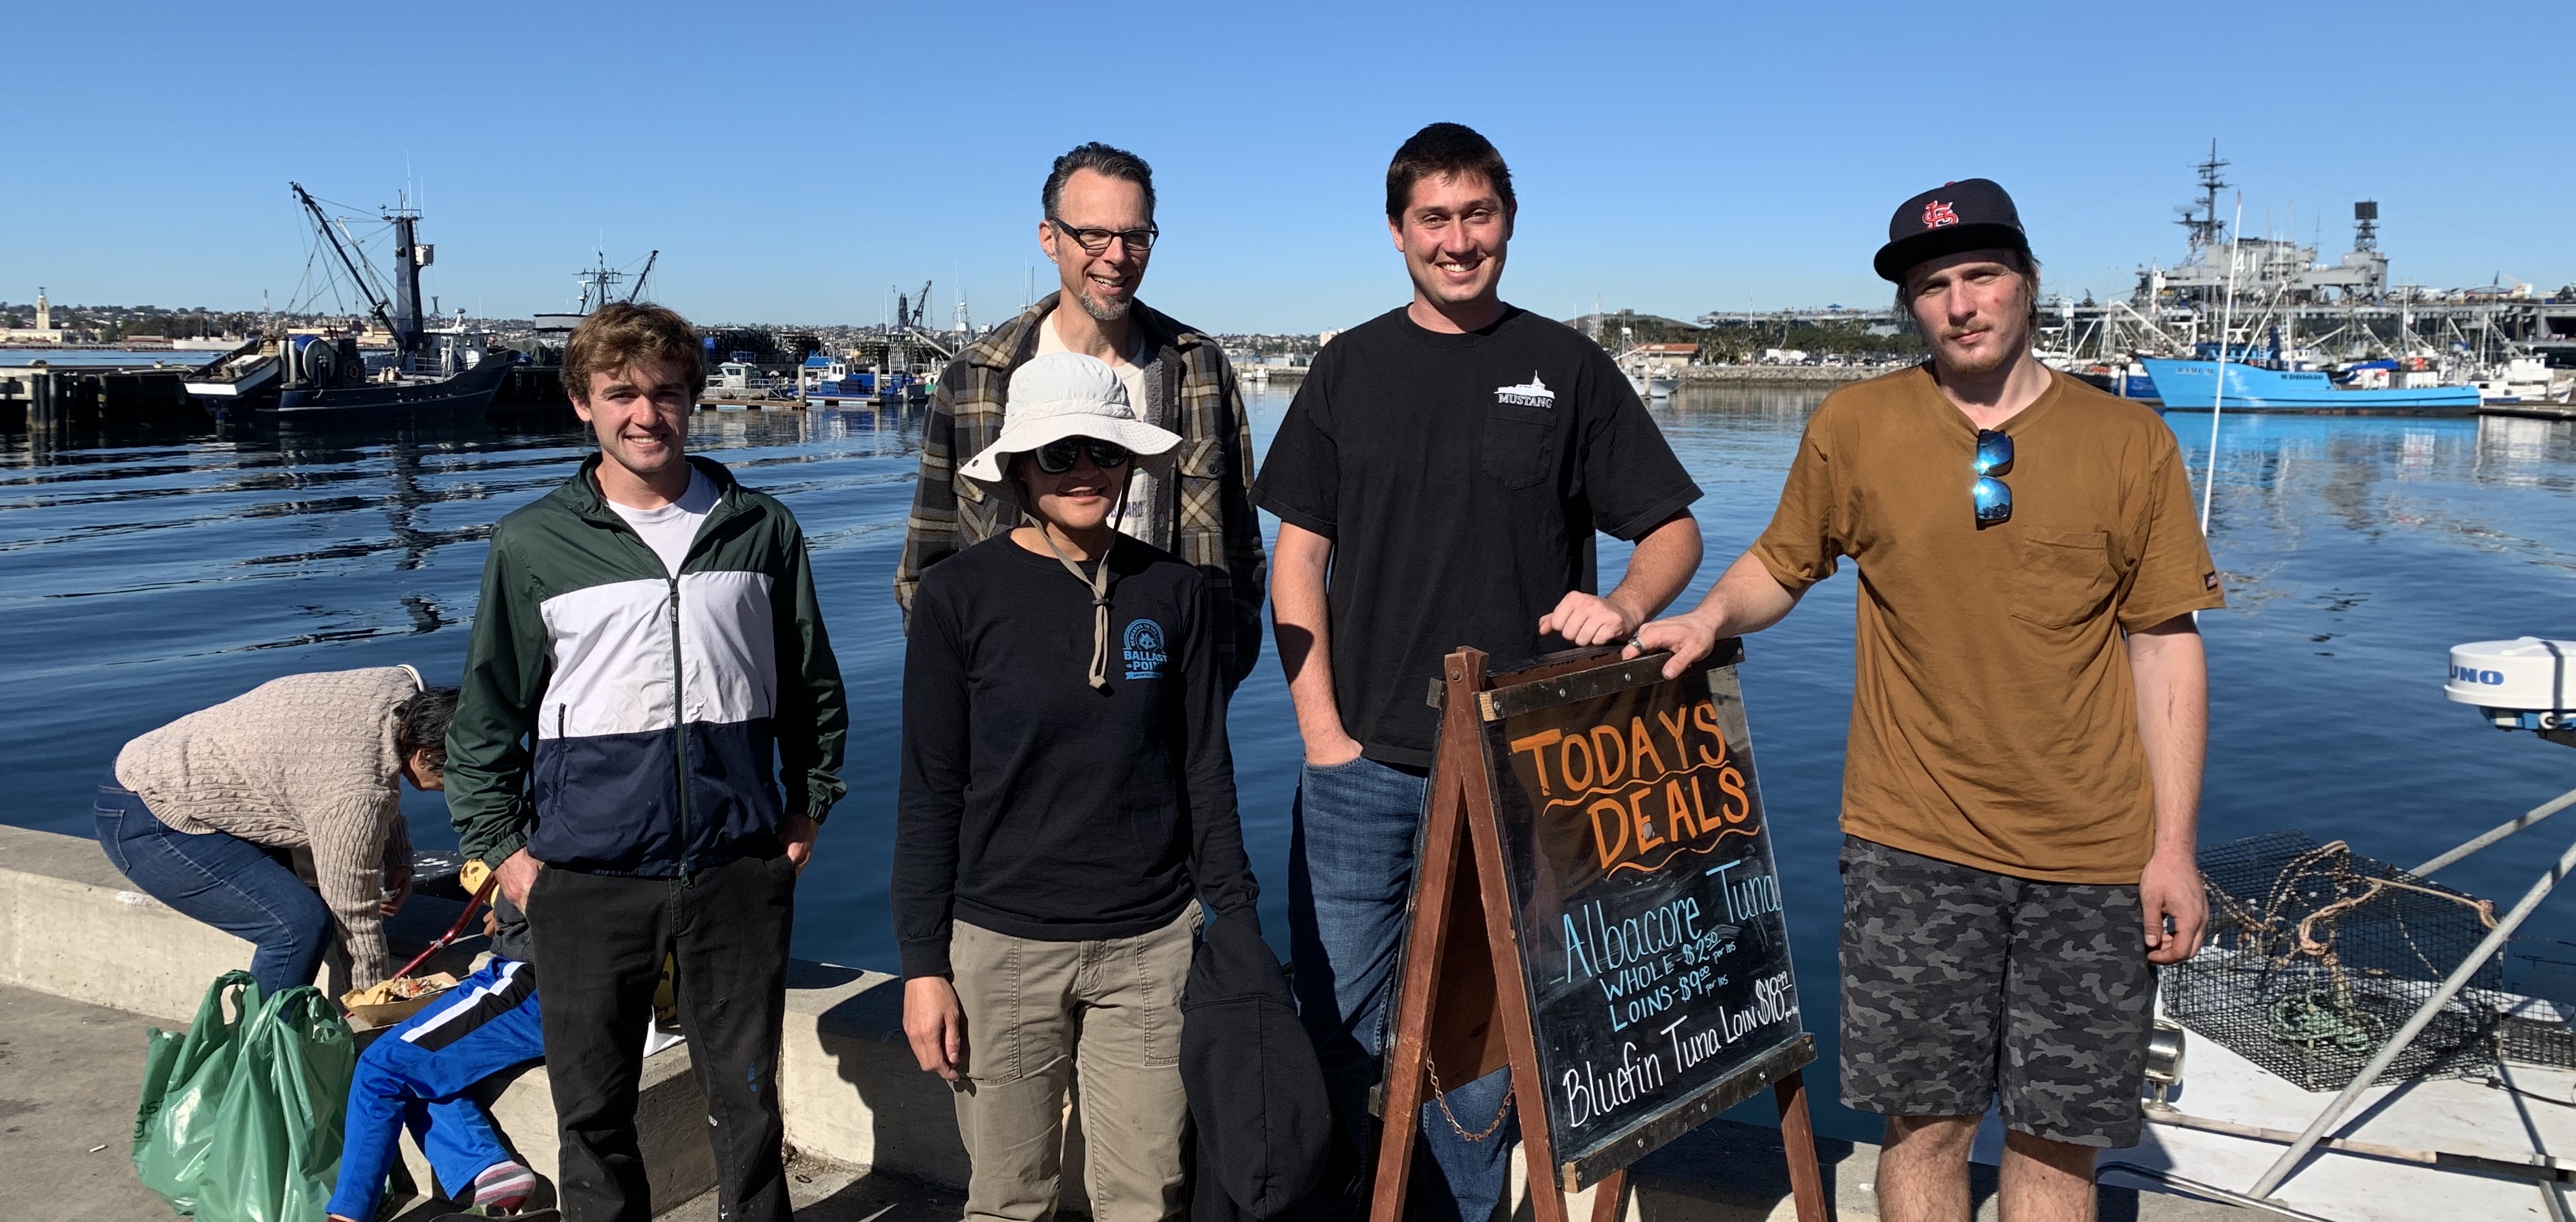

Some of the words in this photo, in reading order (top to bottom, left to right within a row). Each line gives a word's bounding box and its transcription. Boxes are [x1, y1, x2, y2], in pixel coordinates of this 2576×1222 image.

[2235, 253, 2256, 272] 41
[1498, 394, 1553, 408] MUSTANG
[1123, 650, 1167, 663] BALLAST
[1511, 700, 1726, 797] TODAYS
[1587, 767, 1750, 869] DEALS
[1563, 897, 1702, 983] Albacore
[1705, 860, 1783, 923] Tuna
[1563, 1041, 1664, 1128] Bluefin
[1661, 1015, 1722, 1074] Tuna
[1720, 1005, 1757, 1044] LOIN
